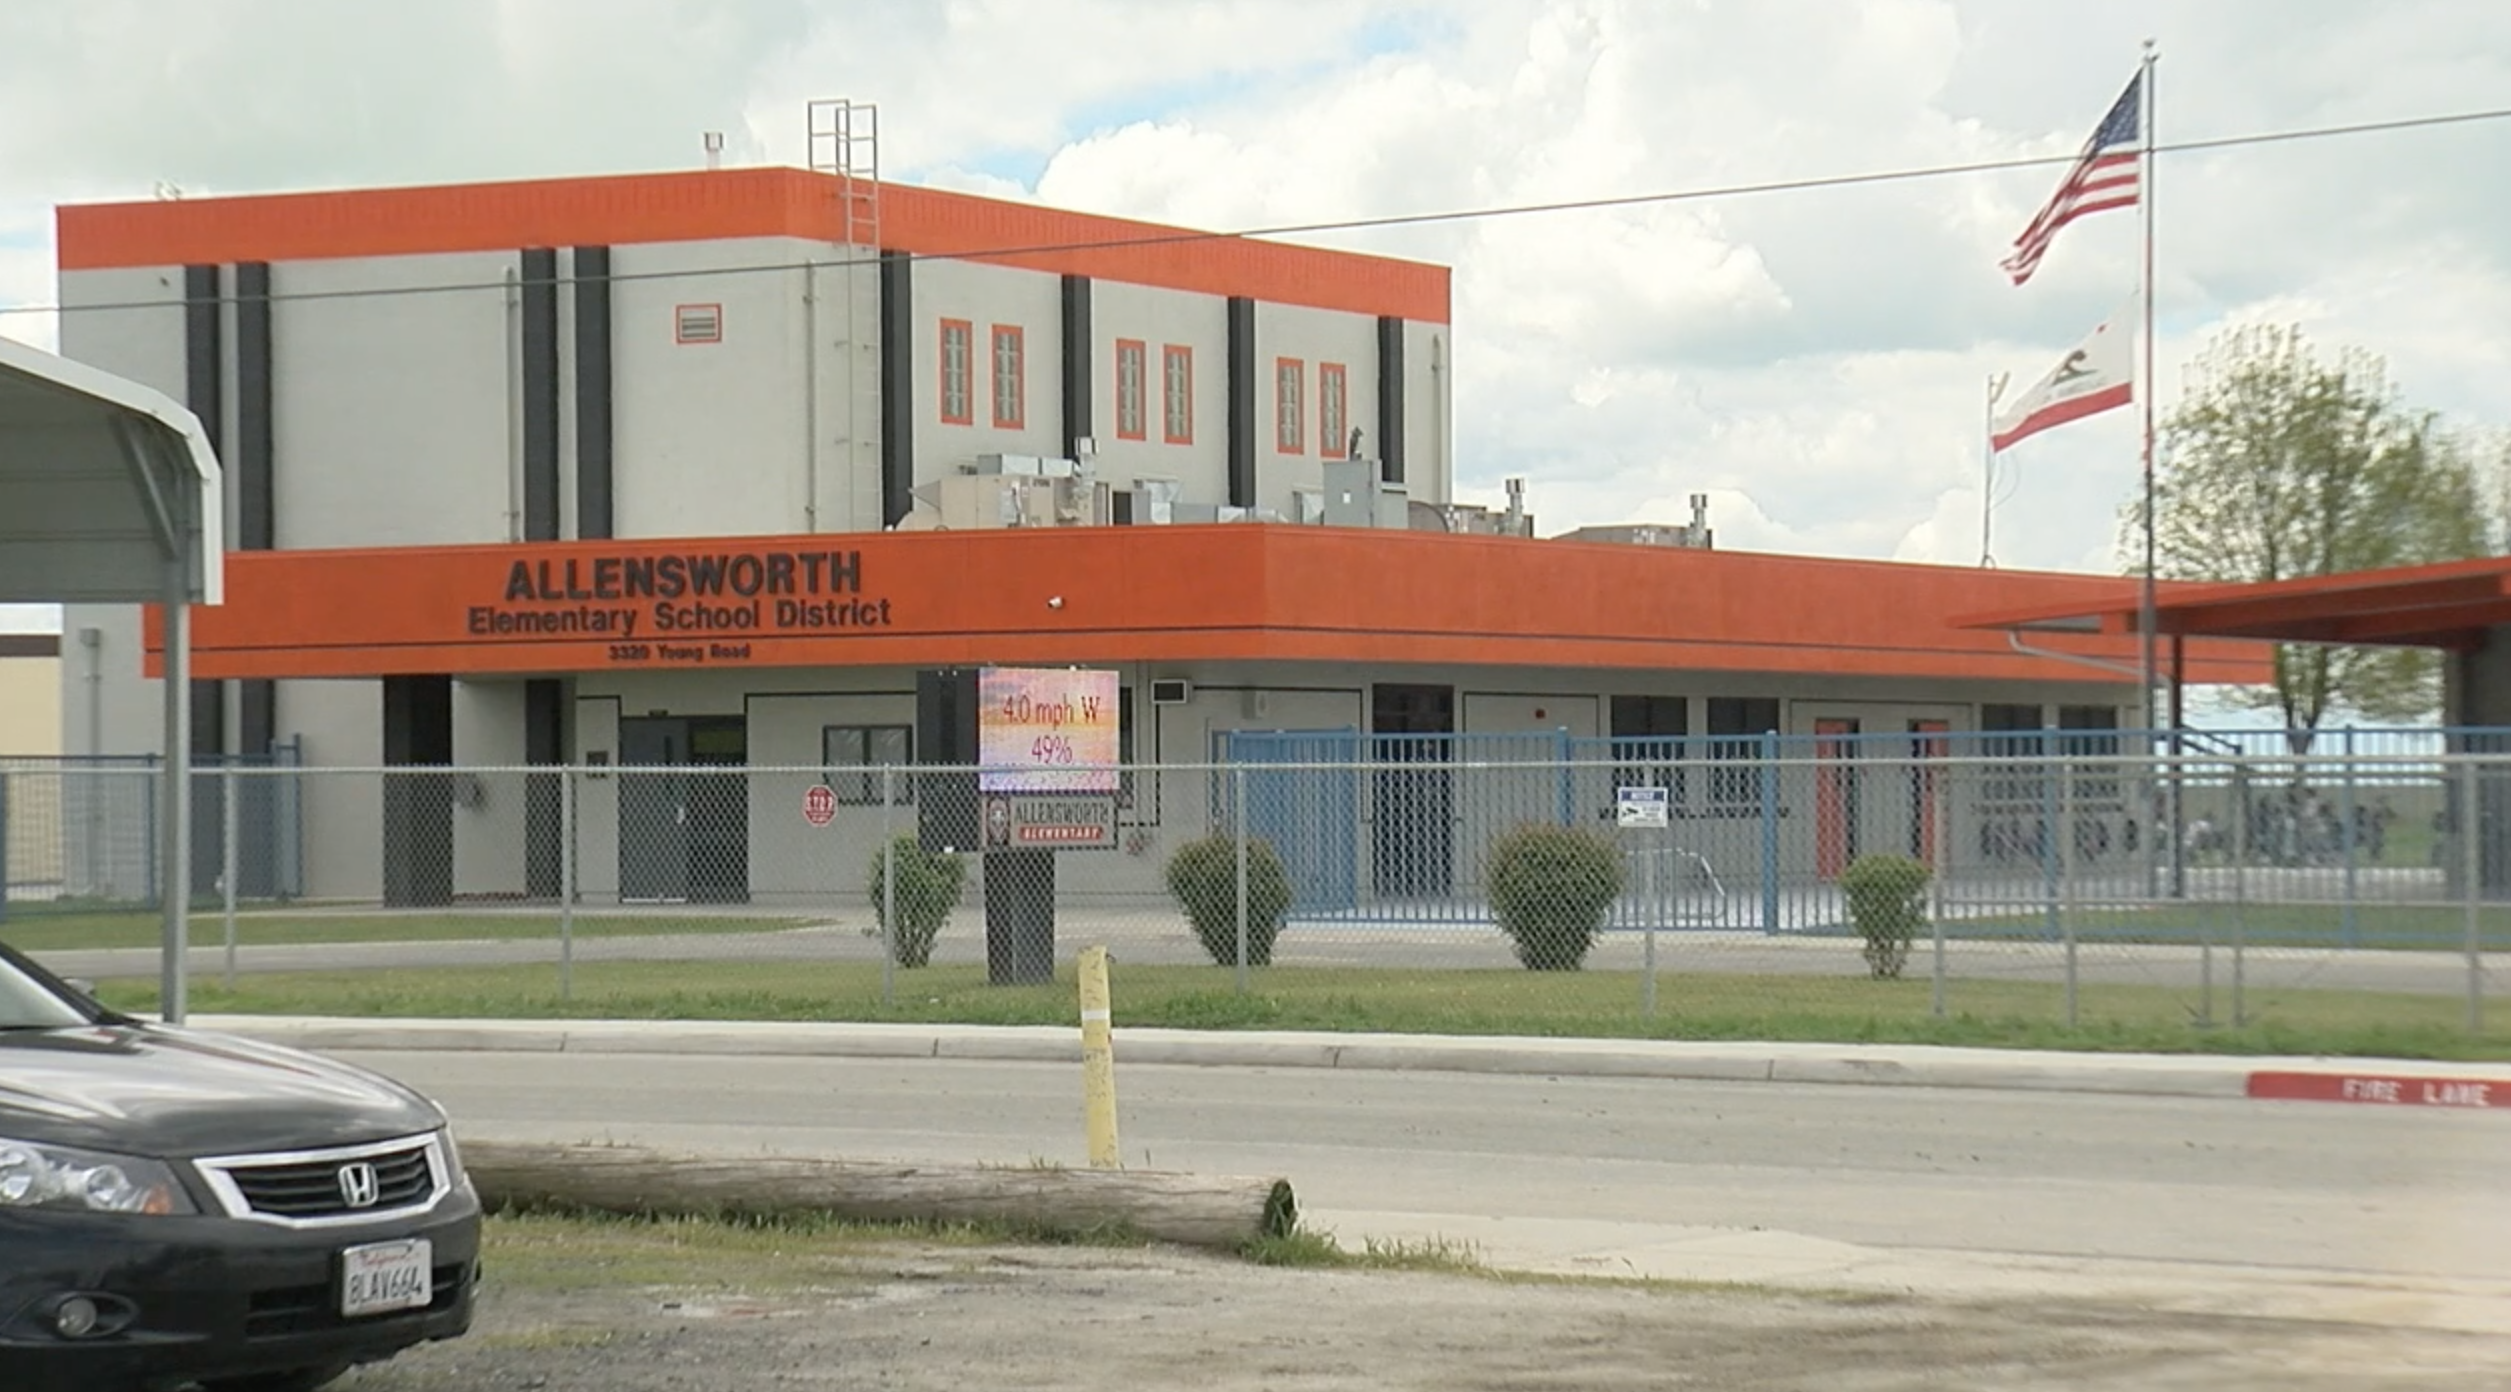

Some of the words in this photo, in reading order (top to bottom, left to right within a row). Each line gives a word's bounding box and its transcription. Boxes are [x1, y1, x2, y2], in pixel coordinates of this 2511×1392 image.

[505, 550, 861, 601] ALLENSWORTH
[468, 605, 637, 636] Elementary
[655, 602, 760, 631] School
[776, 598, 891, 628] District
[656, 643, 704, 662] Young
[710, 642, 751, 658] Road
[1003, 694, 1031, 724] 4.0
[1036, 693, 1074, 731] mph
[1081, 696, 1100, 724] W
[1031, 735, 1073, 764] 49%
[1014, 803, 1108, 824] ALLENSWORTH
[1024, 827, 1100, 839] ELEMENTARY
[2342, 1078, 2402, 1103] FIRE
[2422, 1081, 2492, 1107] LANE
